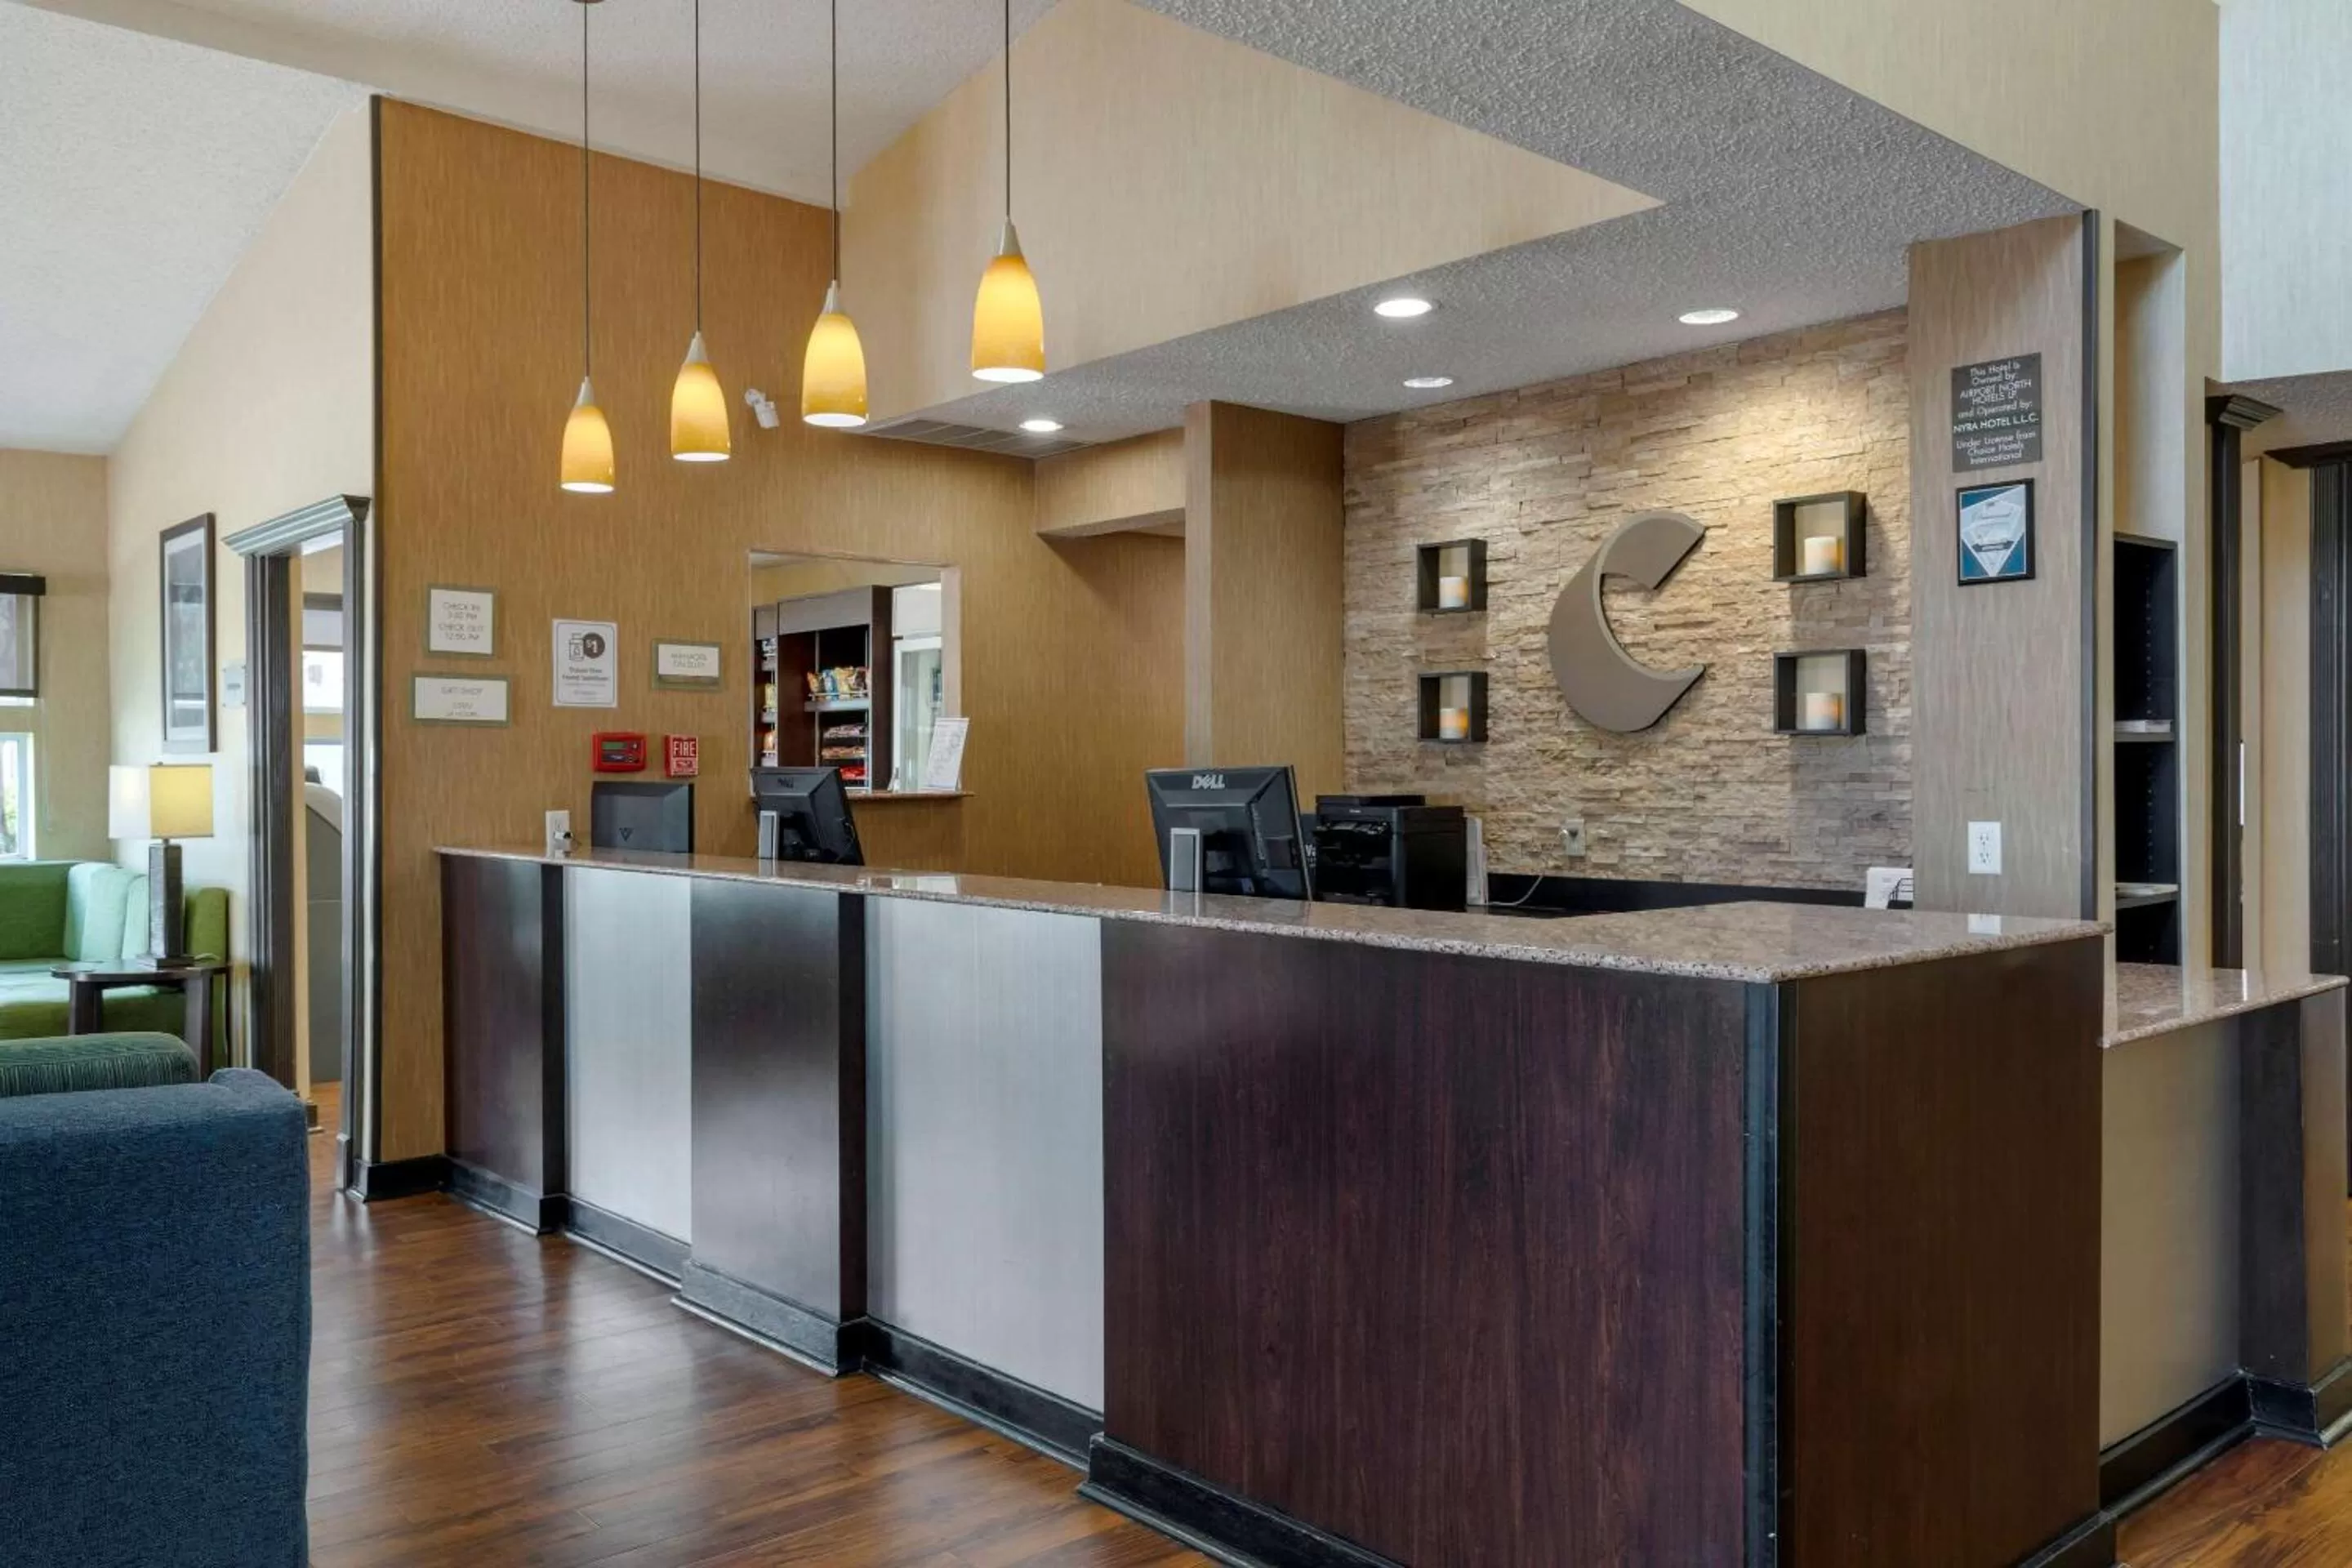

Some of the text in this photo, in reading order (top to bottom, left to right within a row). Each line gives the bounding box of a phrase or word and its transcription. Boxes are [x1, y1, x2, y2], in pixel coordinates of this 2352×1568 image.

[1989, 360, 2011, 373] Hotel
[1972, 372, 2002, 385] Owned
[1960, 378, 2032, 399] AIRPORT NORTH
[1972, 392, 2005, 405] HOTELS
[1958, 408, 1975, 419] and
[1976, 400, 2017, 416] Operated
[1980, 416, 2011, 430] HOTEL
[1956, 430, 2036, 449] Under License from
[1967, 440, 2024, 457] Choice Hotels
[1970, 449, 2022, 465] International
[673, 741, 697, 757] FIRE
[1192, 774, 1225, 790] DELL
